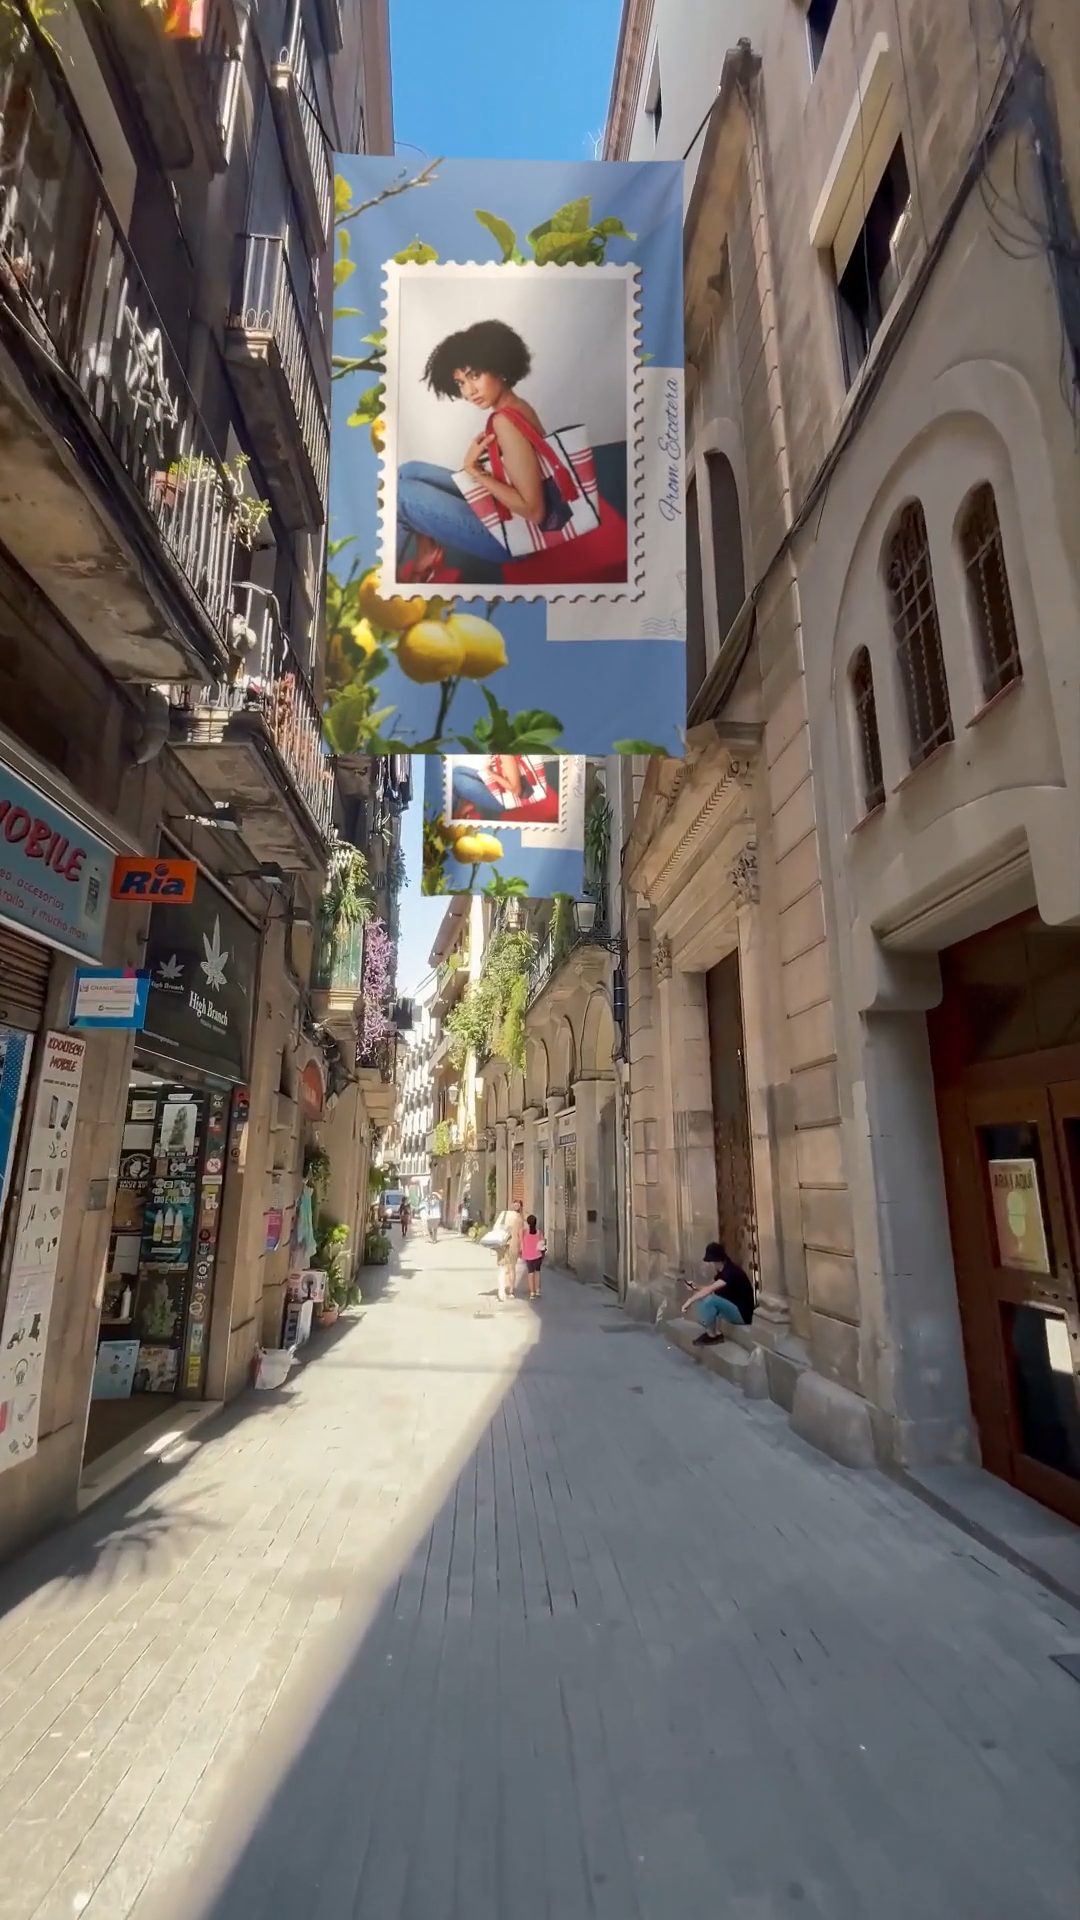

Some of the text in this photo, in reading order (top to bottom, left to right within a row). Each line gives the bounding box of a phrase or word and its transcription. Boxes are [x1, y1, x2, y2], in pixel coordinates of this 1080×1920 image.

[658, 377, 682, 522] From Etcetera
[119, 863, 185, 895] Ria
[189, 990, 228, 1026] High Branch
